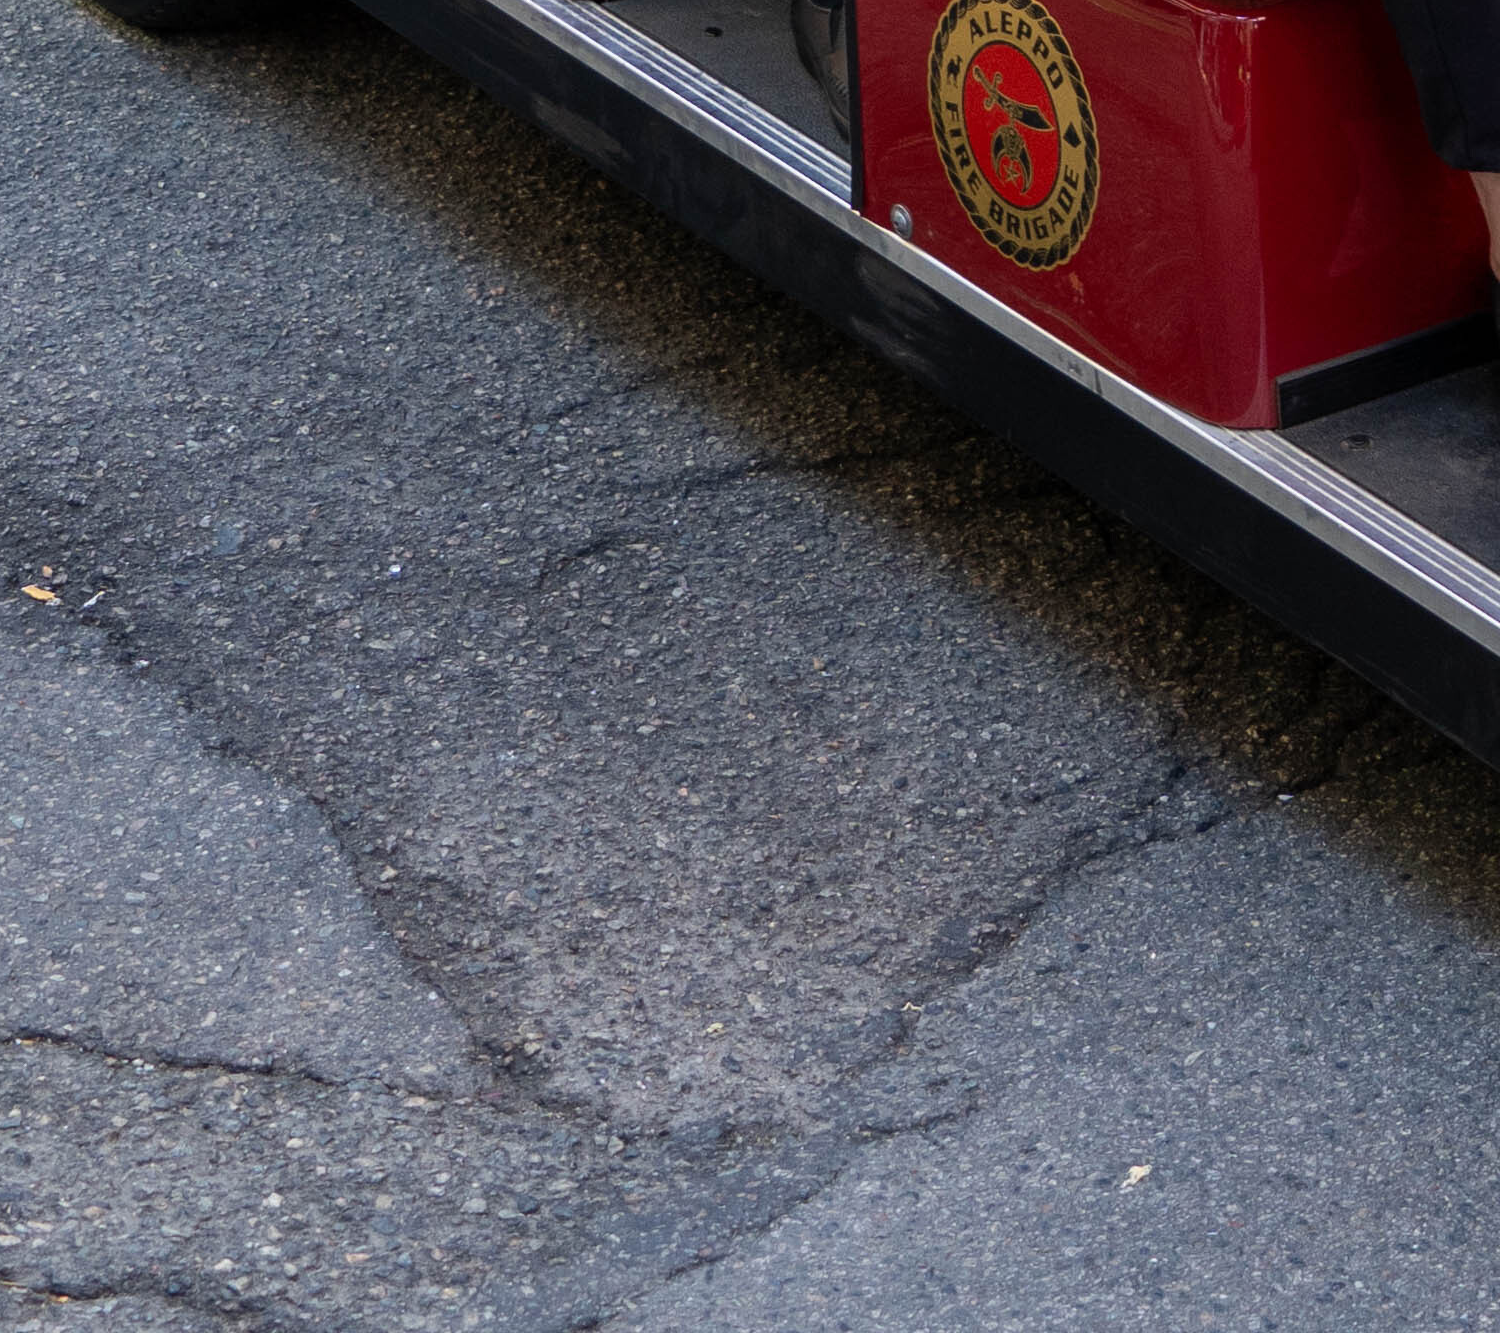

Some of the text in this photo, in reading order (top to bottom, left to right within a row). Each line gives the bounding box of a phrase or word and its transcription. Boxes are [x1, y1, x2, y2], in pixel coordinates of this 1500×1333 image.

[969, 10, 1065, 91] ALEPPO
[945, 99, 1080, 242] FIRE BRIGADE
